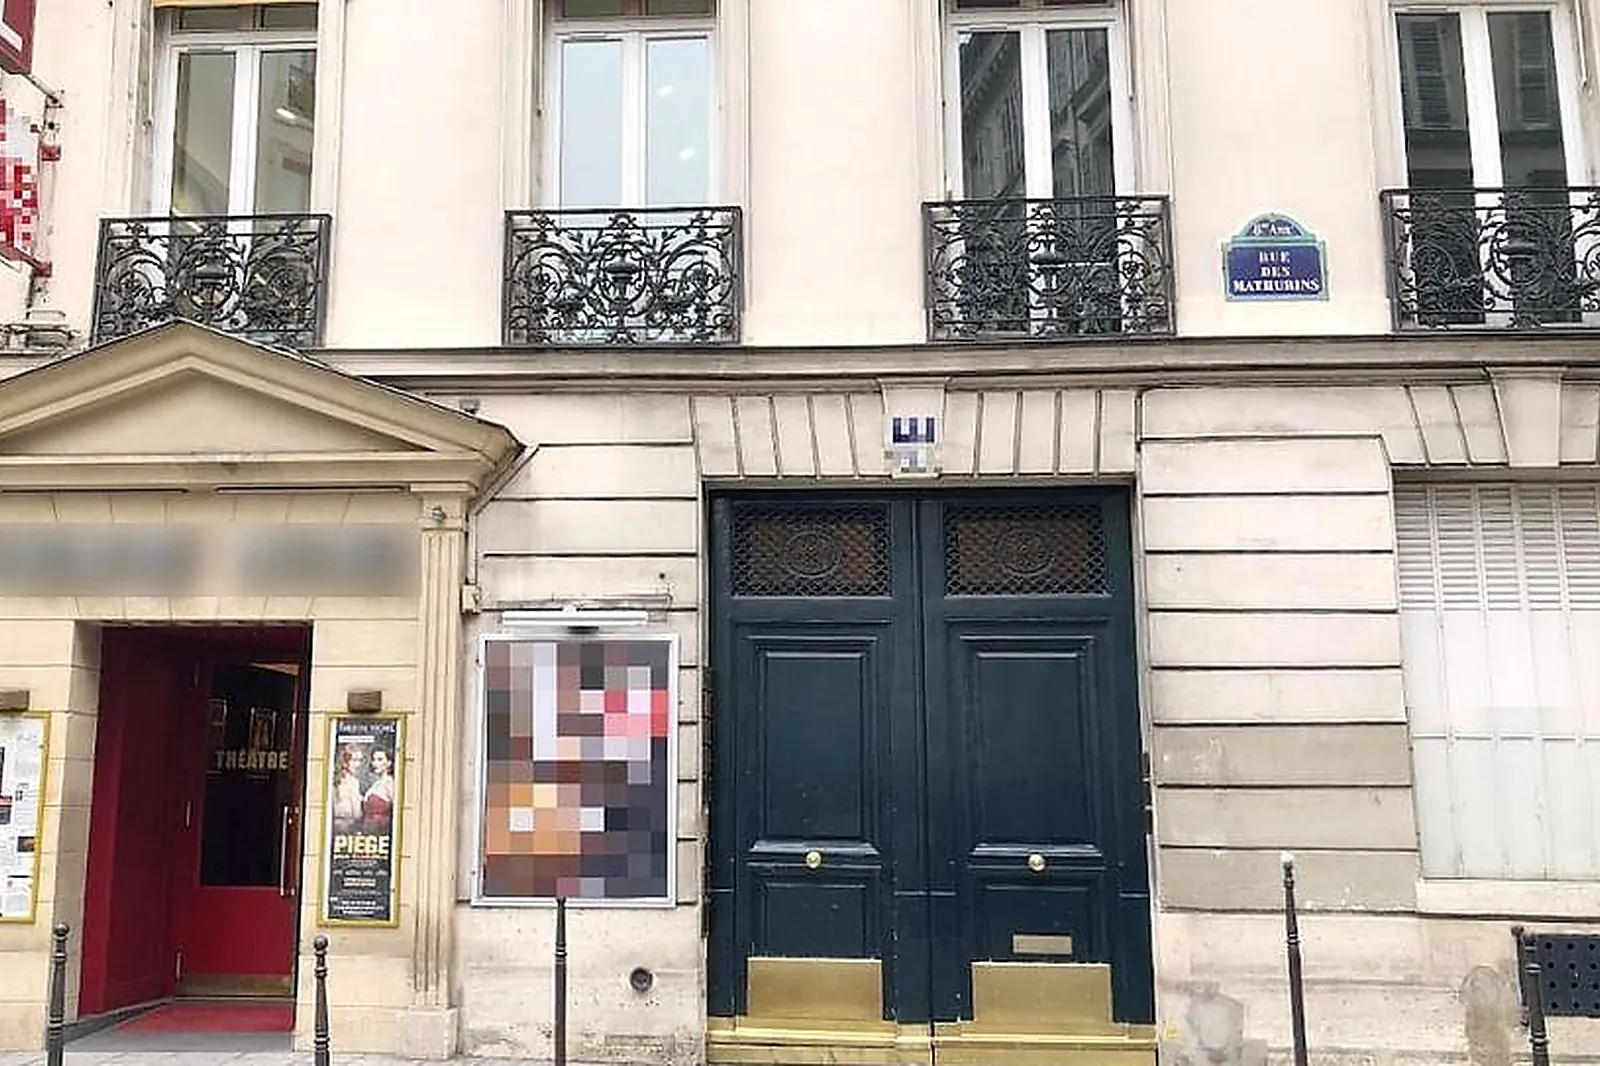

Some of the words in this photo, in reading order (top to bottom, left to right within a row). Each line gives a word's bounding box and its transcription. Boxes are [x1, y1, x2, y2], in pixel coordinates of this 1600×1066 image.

[1259, 251, 1290, 263] RUE
[1261, 266, 1290, 278] DES
[1233, 279, 1320, 293] MATHURINS
